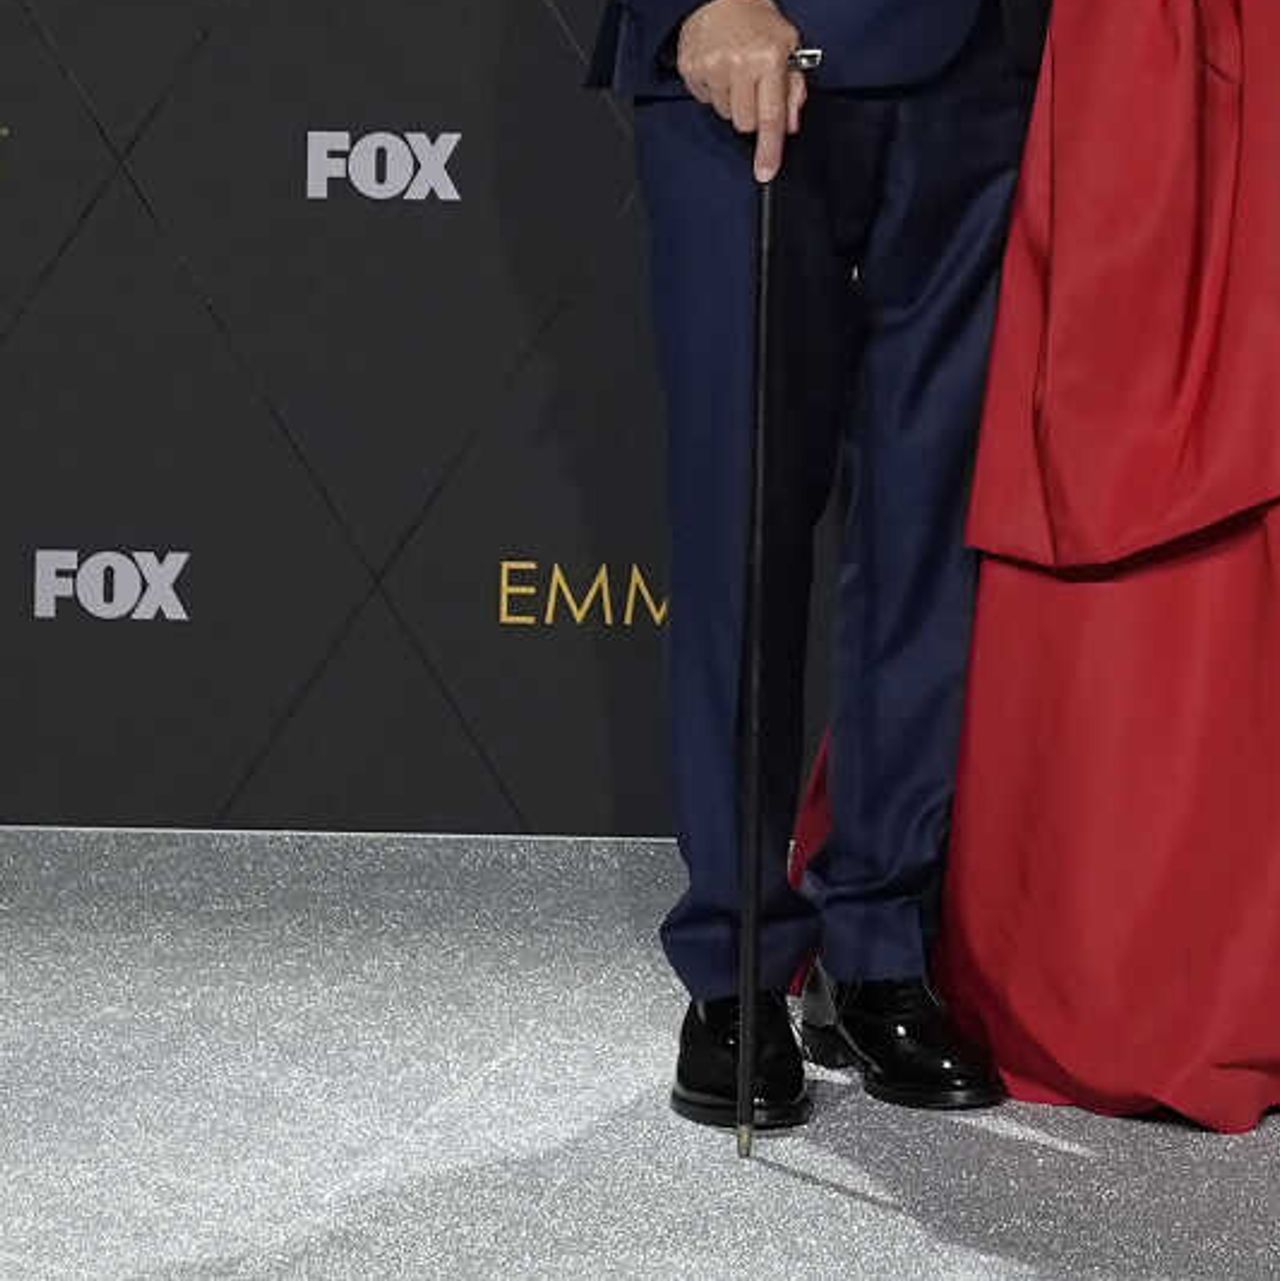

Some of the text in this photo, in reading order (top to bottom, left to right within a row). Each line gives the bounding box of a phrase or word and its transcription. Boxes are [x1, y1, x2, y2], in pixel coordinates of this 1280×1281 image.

[306, 131, 461, 200] FOX
[34, 549, 190, 621] FOX
[499, 561, 668, 625] EMM
